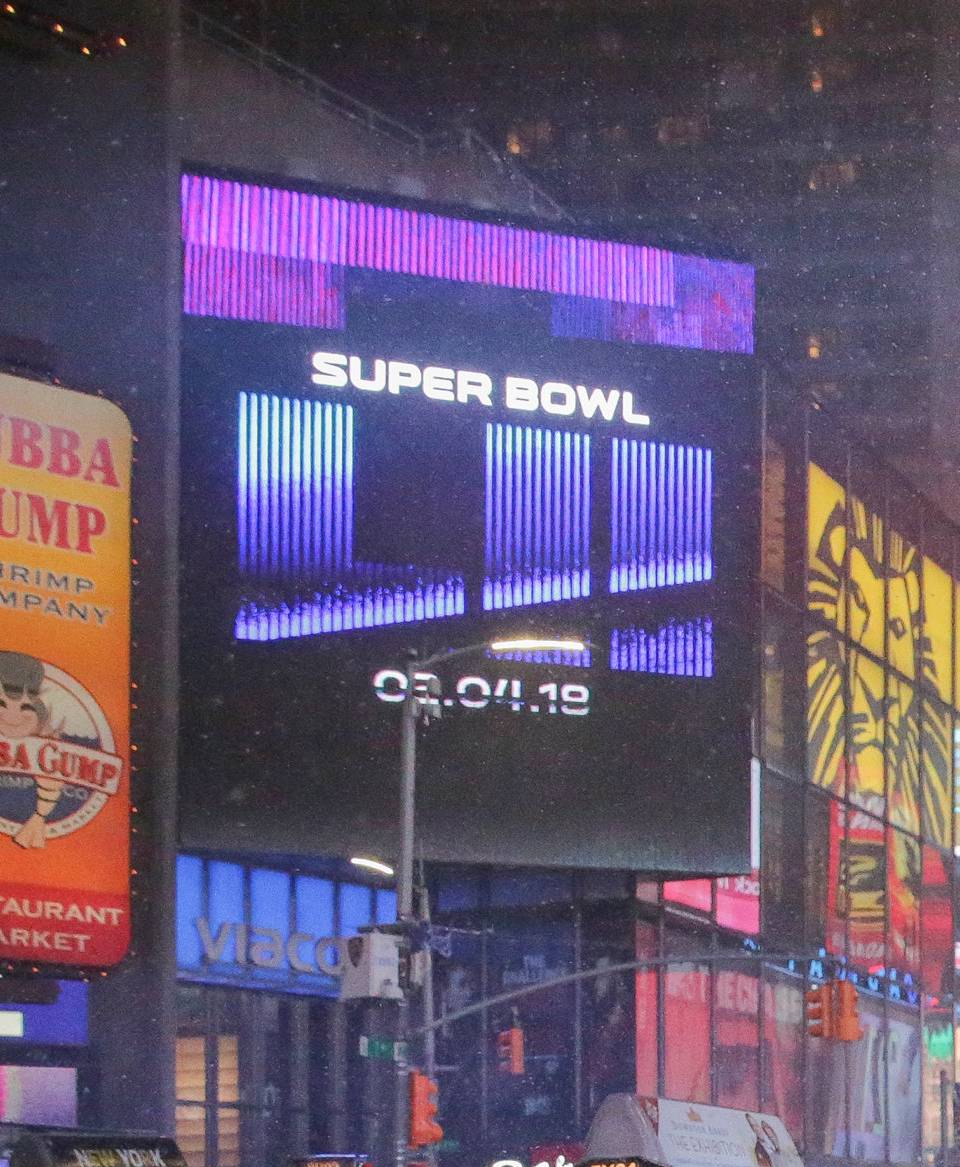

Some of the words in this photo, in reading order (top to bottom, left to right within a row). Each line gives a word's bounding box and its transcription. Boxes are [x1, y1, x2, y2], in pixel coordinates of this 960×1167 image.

[311, 351, 493, 406] SUPER
[505, 376, 651, 426] BOWL
[0, 415, 120, 487] BBA
[38, 741, 118, 788] GUMP
[195, 916, 350, 977] viaco
[73, 1148, 119, 1167] NEW
[116, 1148, 167, 1167] YORK
